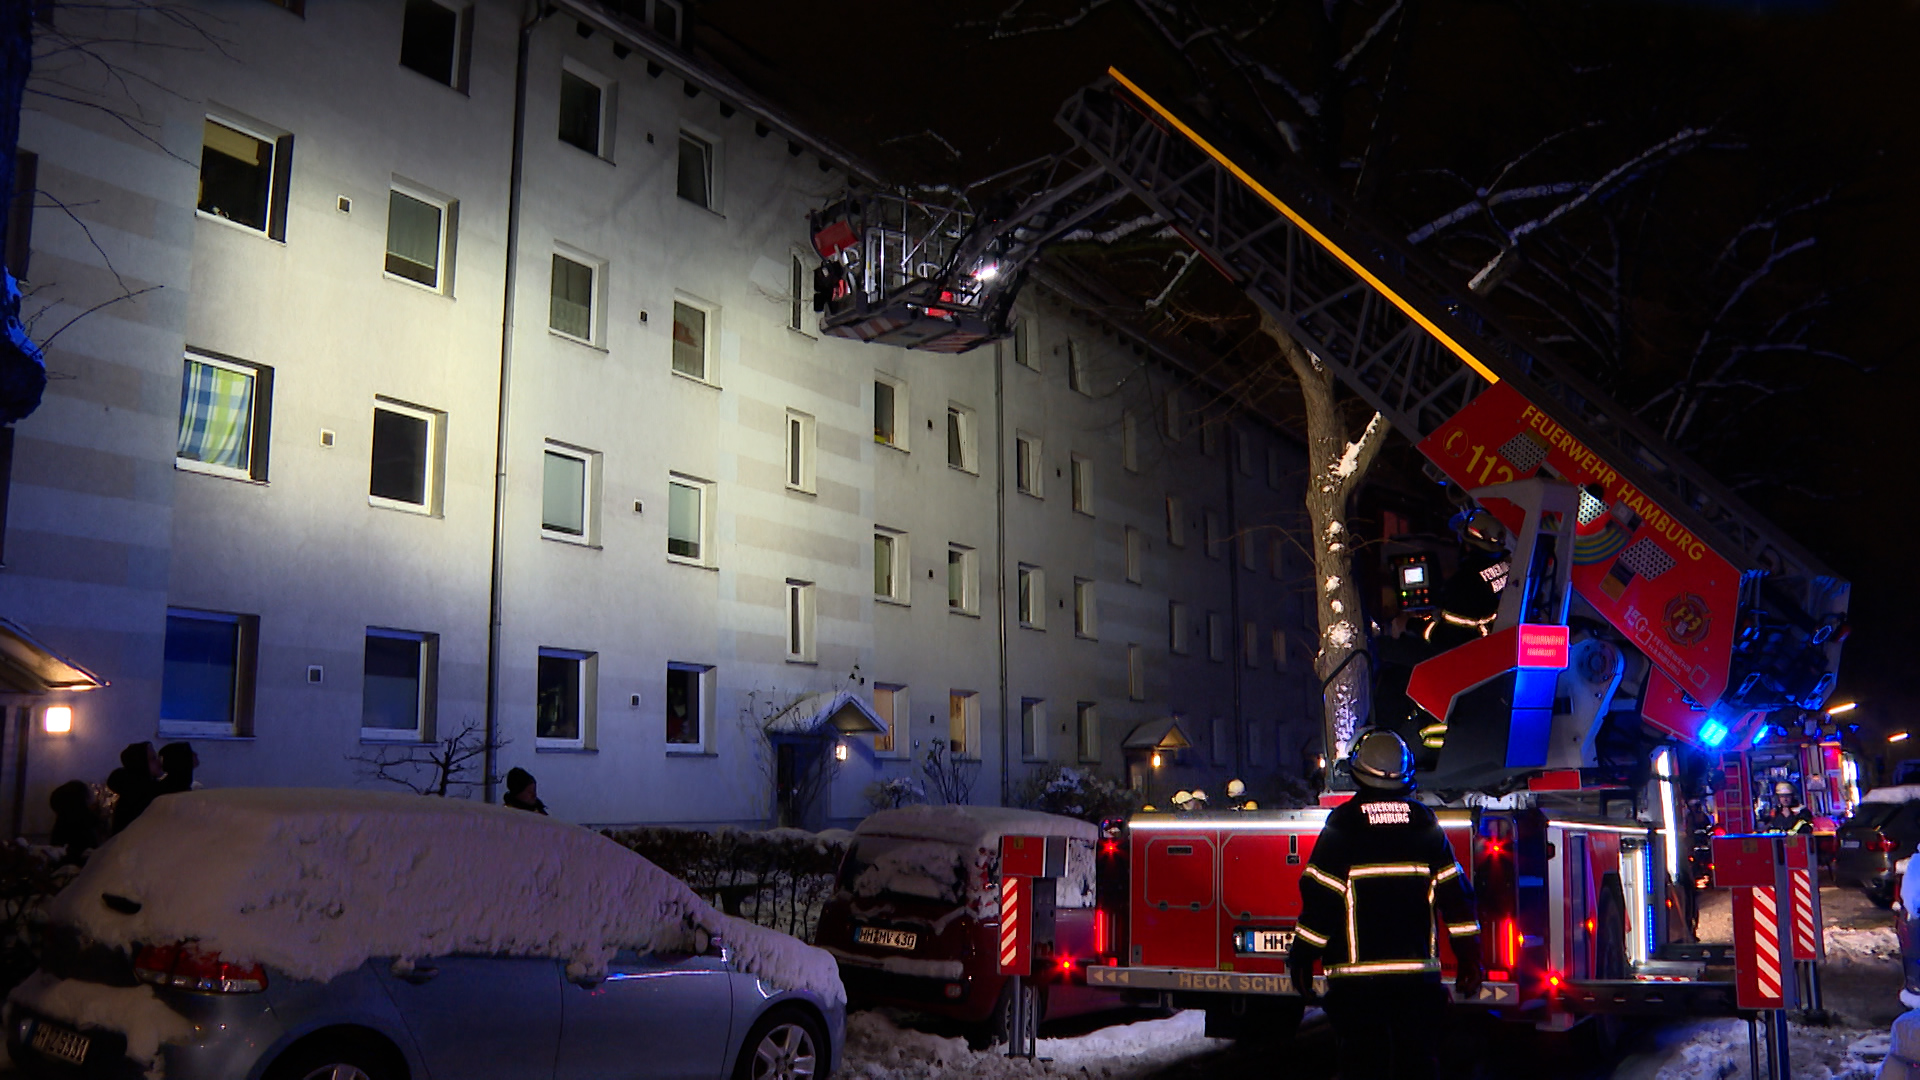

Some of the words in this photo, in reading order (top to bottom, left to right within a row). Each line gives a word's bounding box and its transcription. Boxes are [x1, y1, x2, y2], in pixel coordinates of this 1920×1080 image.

[1521, 404, 1616, 488] FEUERWEHR
[1616, 482, 1706, 561] HAMBURG
[1360, 801, 1411, 813] FEUERWEHR
[1368, 812, 1410, 824] HAMBURG
[1263, 935, 1284, 950] HH
[1178, 973, 1233, 990] HECK
